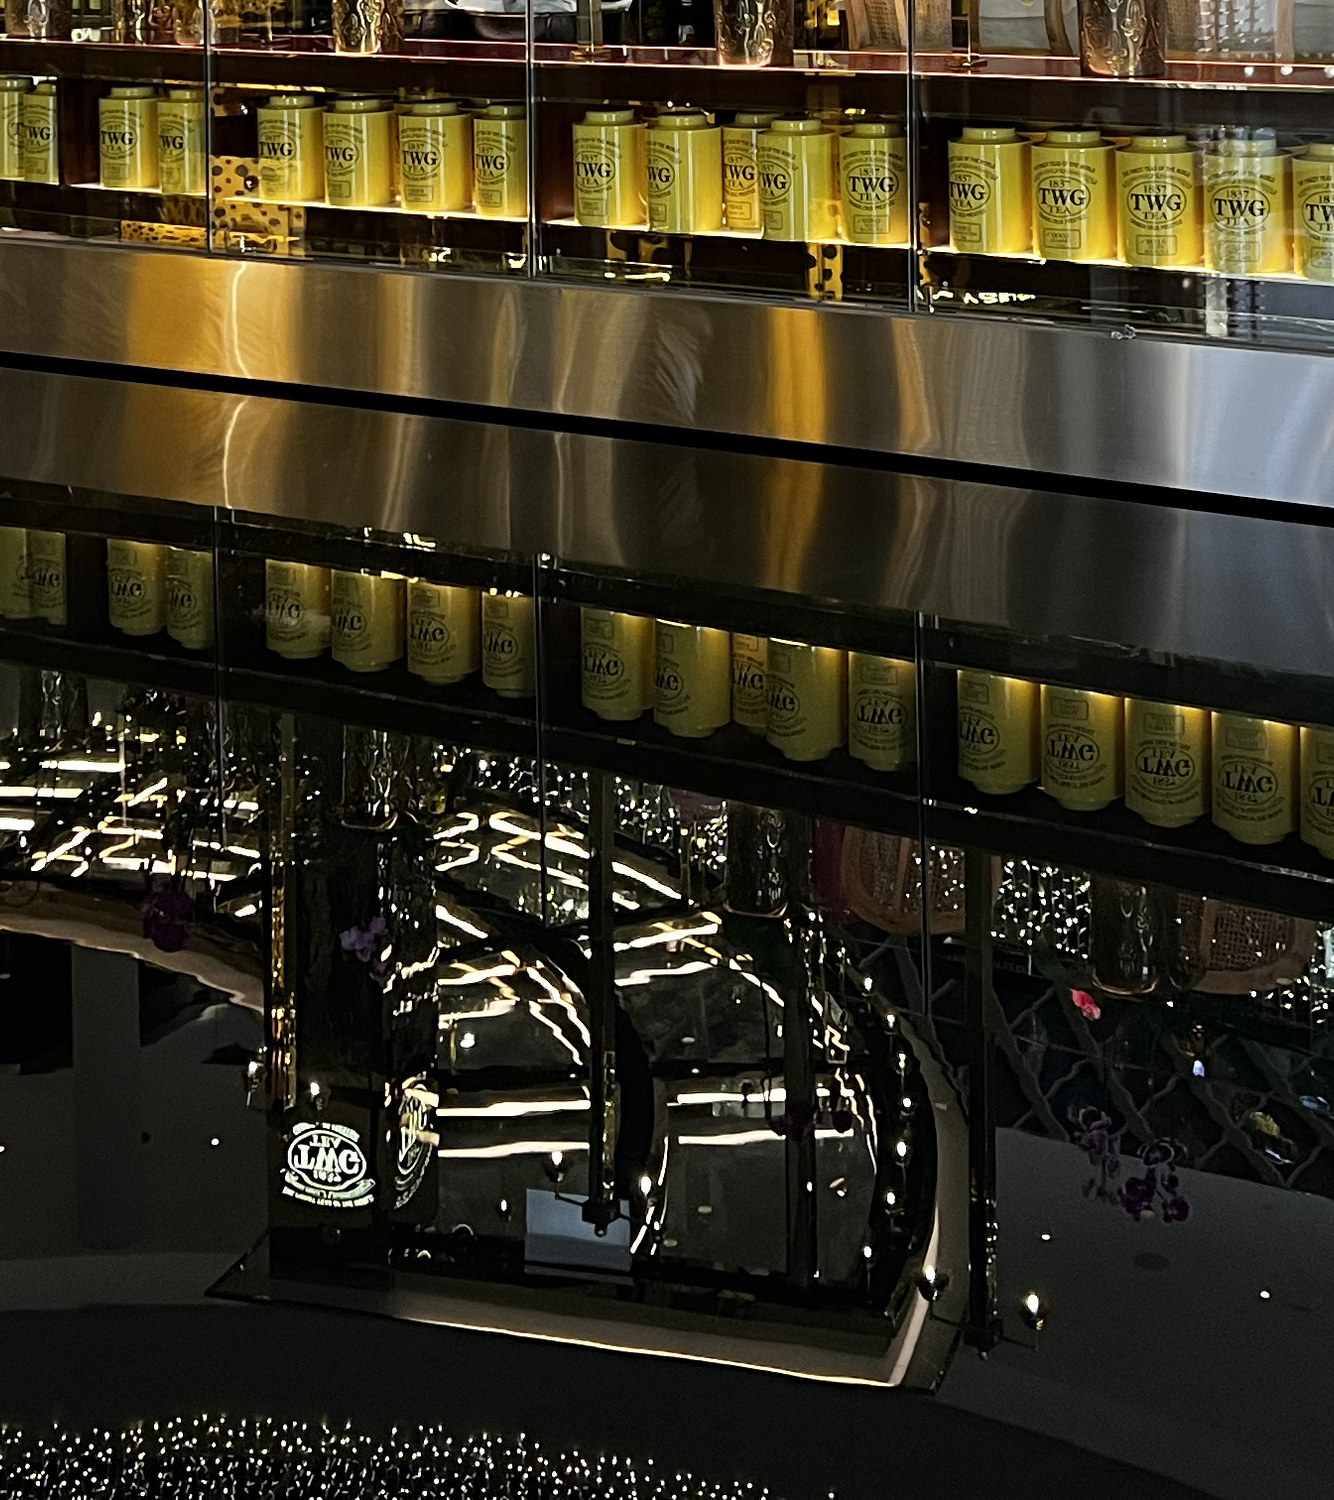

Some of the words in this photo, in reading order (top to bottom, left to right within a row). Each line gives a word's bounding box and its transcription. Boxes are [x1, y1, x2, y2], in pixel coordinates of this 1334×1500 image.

[101, 131, 133, 145] TWG
[259, 141, 293, 157] TWG
[402, 150, 437, 166] TWG
[576, 161, 612, 178] TWG
[724, 164, 755, 181] TWG
[581, 178, 599, 186] TEA
[953, 174, 972, 183] 1837
[727, 180, 744, 188] TEA
[848, 176, 896, 193] TWG
[1049, 179, 1071, 188] 1837
[949, 182, 985, 201] TWG
[1143, 185, 1167, 194] 1837
[858, 193, 881, 201] TEA
[1039, 188, 1087, 206] TWG
[1225, 190, 1250, 199] 1837
[954, 200, 972, 208] TEA
[1130, 193, 1181, 212] TWG
[1047, 206, 1072, 214] TEA
[1213, 198, 1265, 217] TWG
[1142, 211, 1168, 220] TEA
[1226, 217, 1251, 226] TEA
